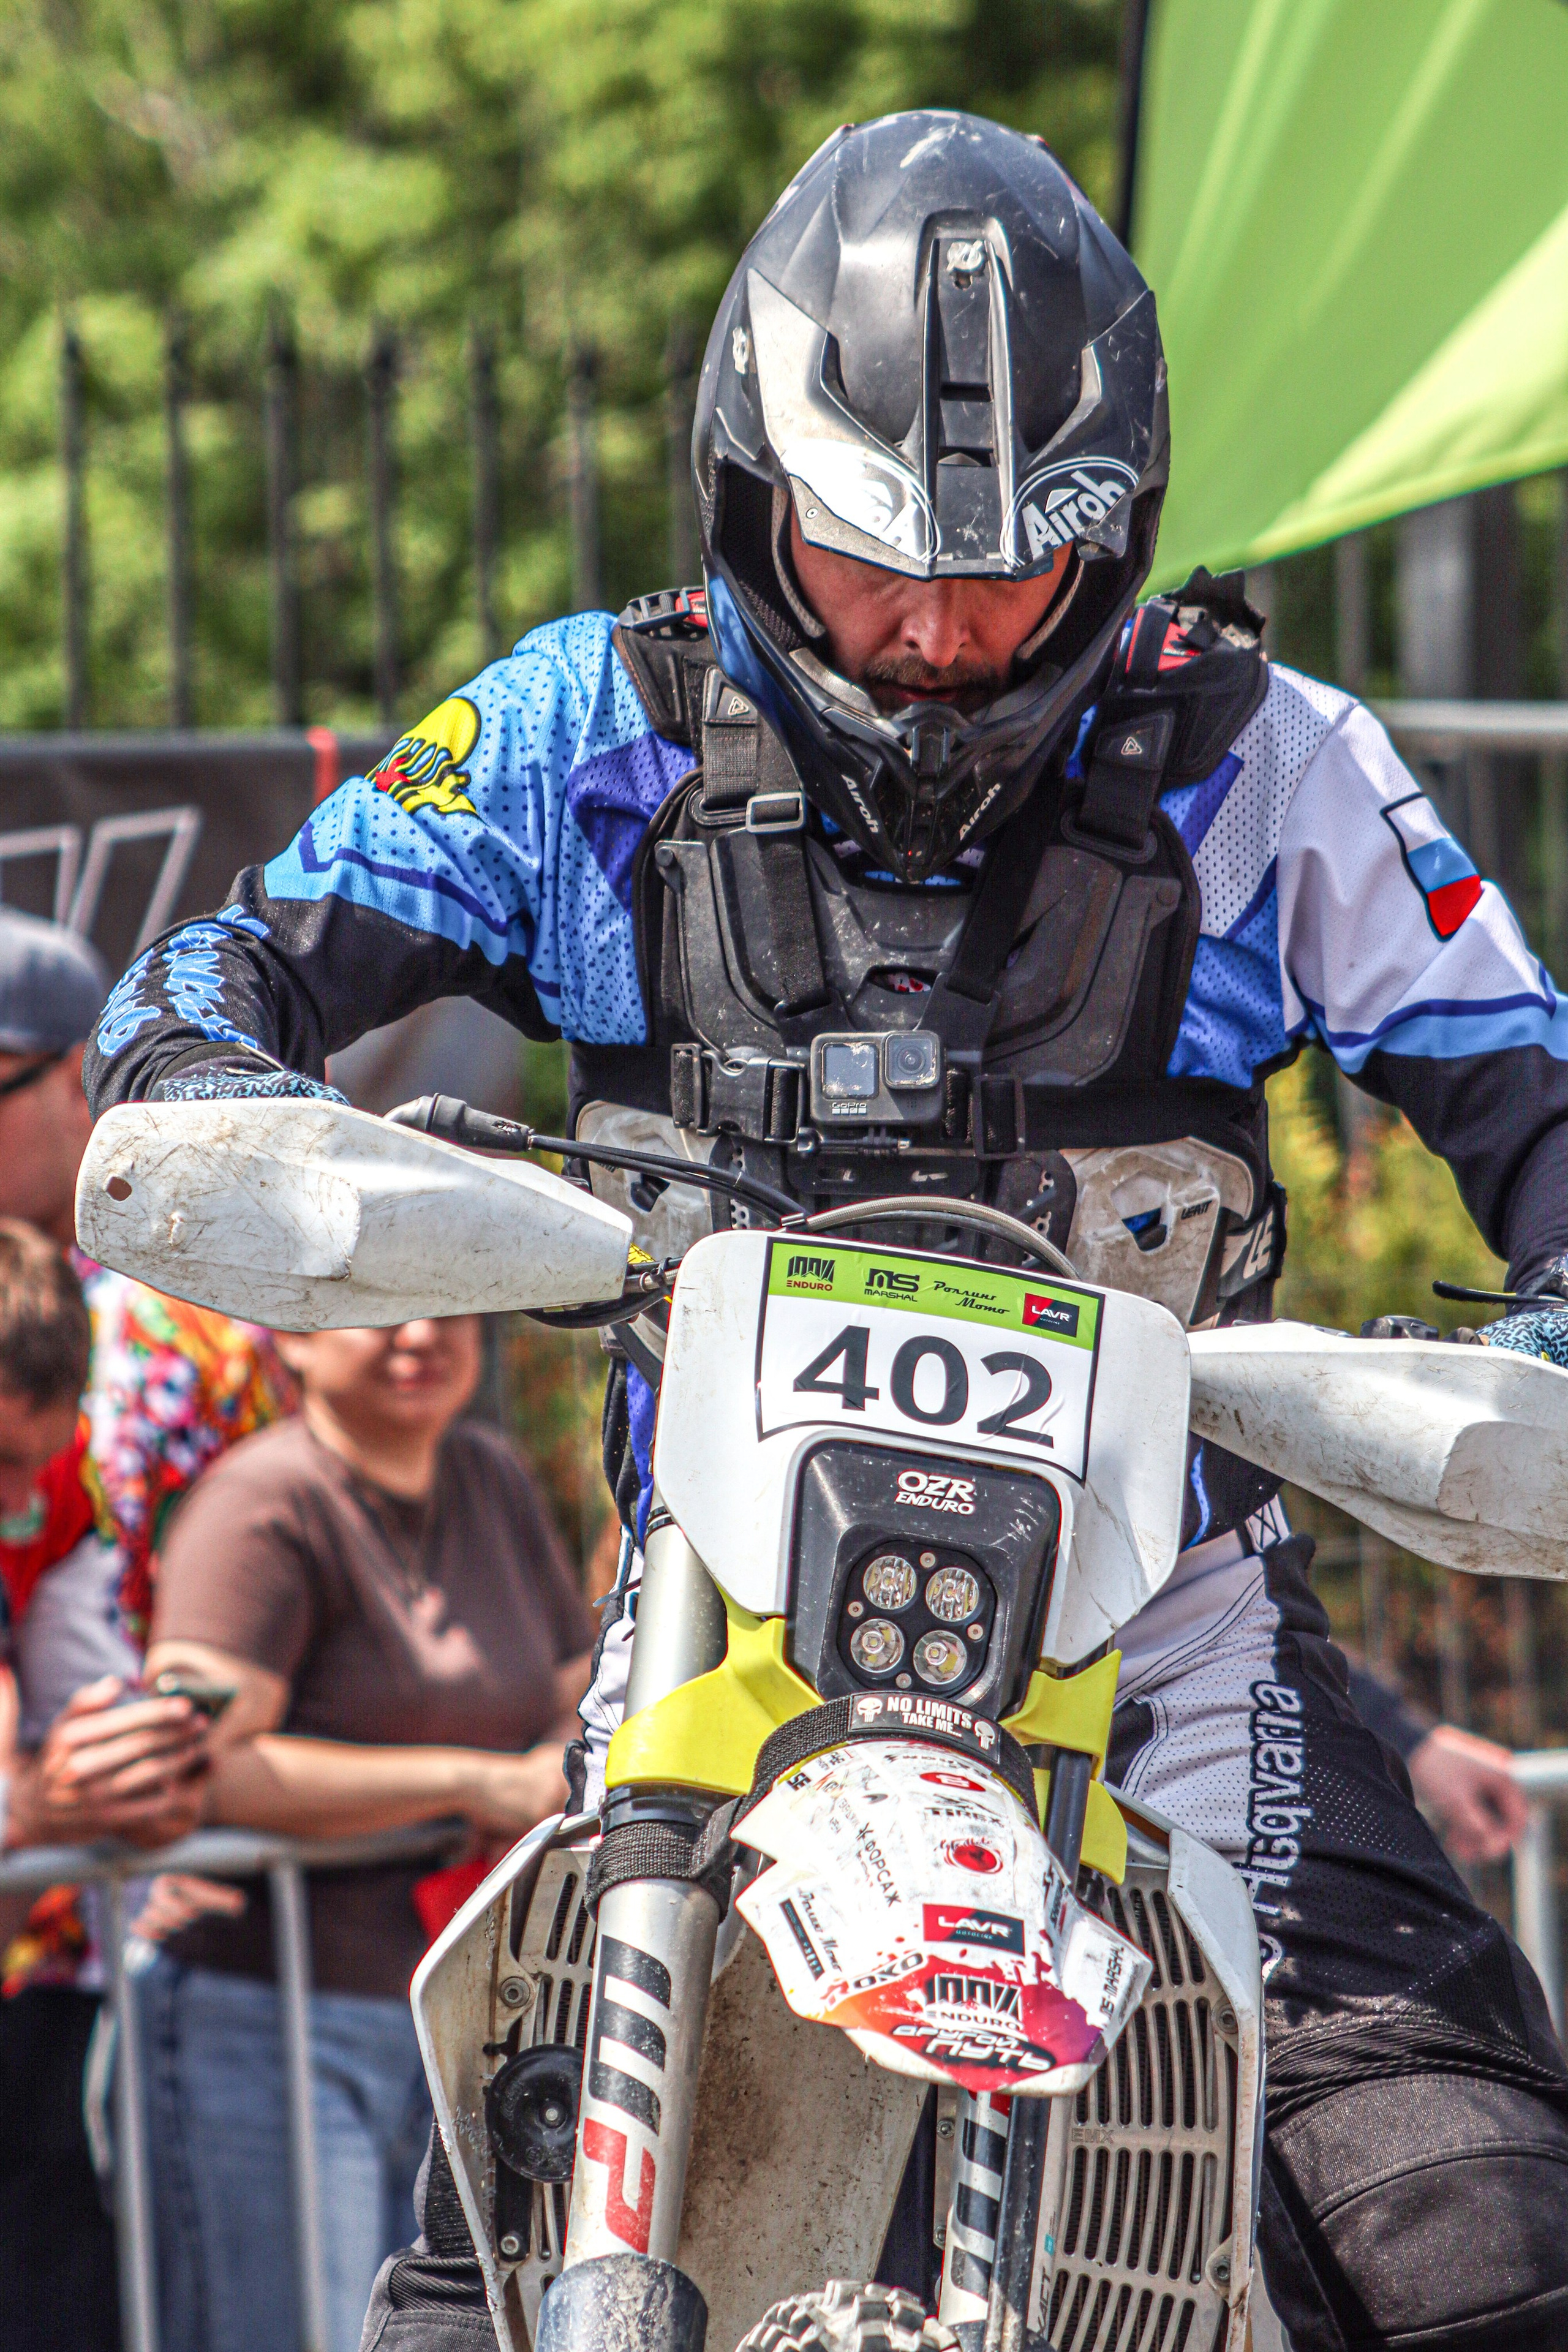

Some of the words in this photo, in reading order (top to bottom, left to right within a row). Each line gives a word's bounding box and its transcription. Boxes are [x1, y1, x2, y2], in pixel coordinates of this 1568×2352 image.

[1022, 470, 1127, 561] Airoh
[841, 774, 880, 834] Airoh
[959, 783, 1002, 842] Airoh
[1180, 1200, 1213, 1221] LEATT
[786, 1280, 833, 1292] ENDURO
[864, 1288, 918, 1303] MARSHAL
[955, 1297, 1011, 1314] Мото
[1031, 1305, 1071, 1322] LAVR
[793, 1325, 1054, 1449] 402
[897, 1470, 974, 1502] OZR
[895, 1491, 975, 1515] ENDURO
[887, 1697, 913, 1713] NO
[916, 1698, 973, 1730] LIMITS
[902, 1713, 934, 1729] TAKE
[937, 1915, 1010, 1938] LAVR
[925, 2010, 1025, 2031] ENDURO
[1071, 2128, 1115, 2144] EMX
